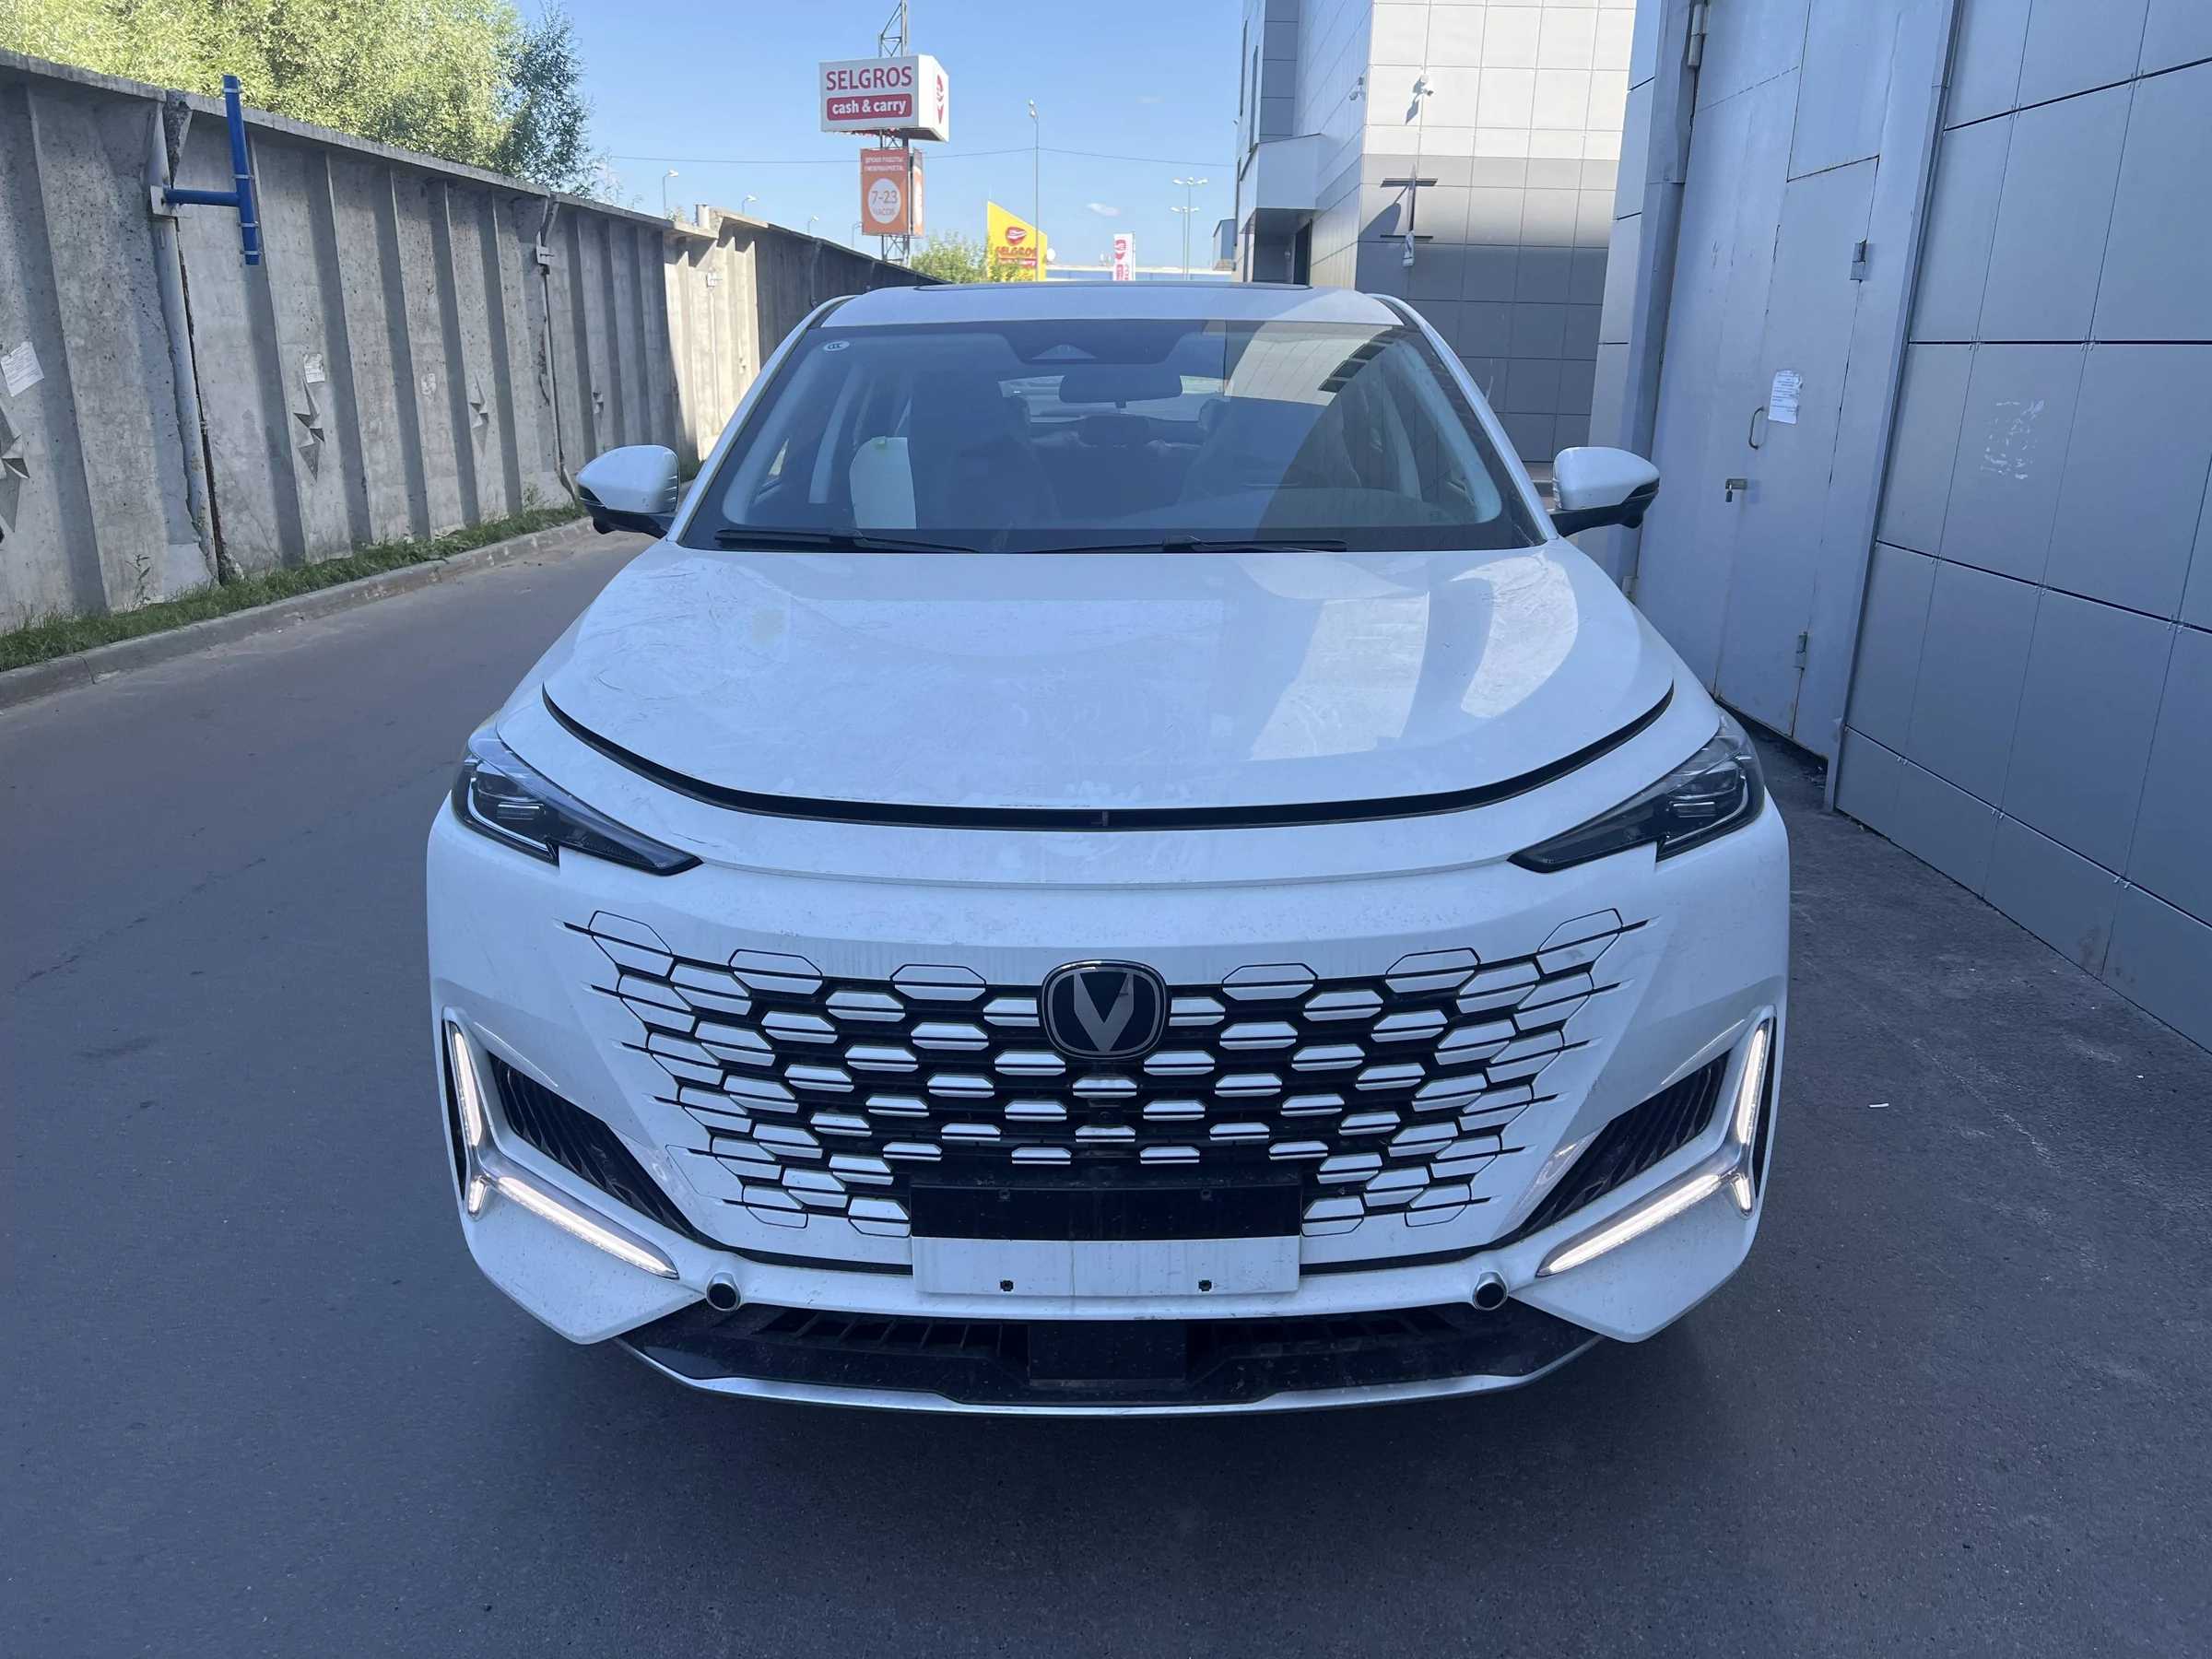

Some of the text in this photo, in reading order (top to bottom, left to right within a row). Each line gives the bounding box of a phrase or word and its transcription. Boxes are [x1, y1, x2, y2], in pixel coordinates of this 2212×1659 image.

[826, 65, 912, 91] SELGROS
[832, 99, 906, 114] cash & carry
[871, 190, 898, 205] 7-23
